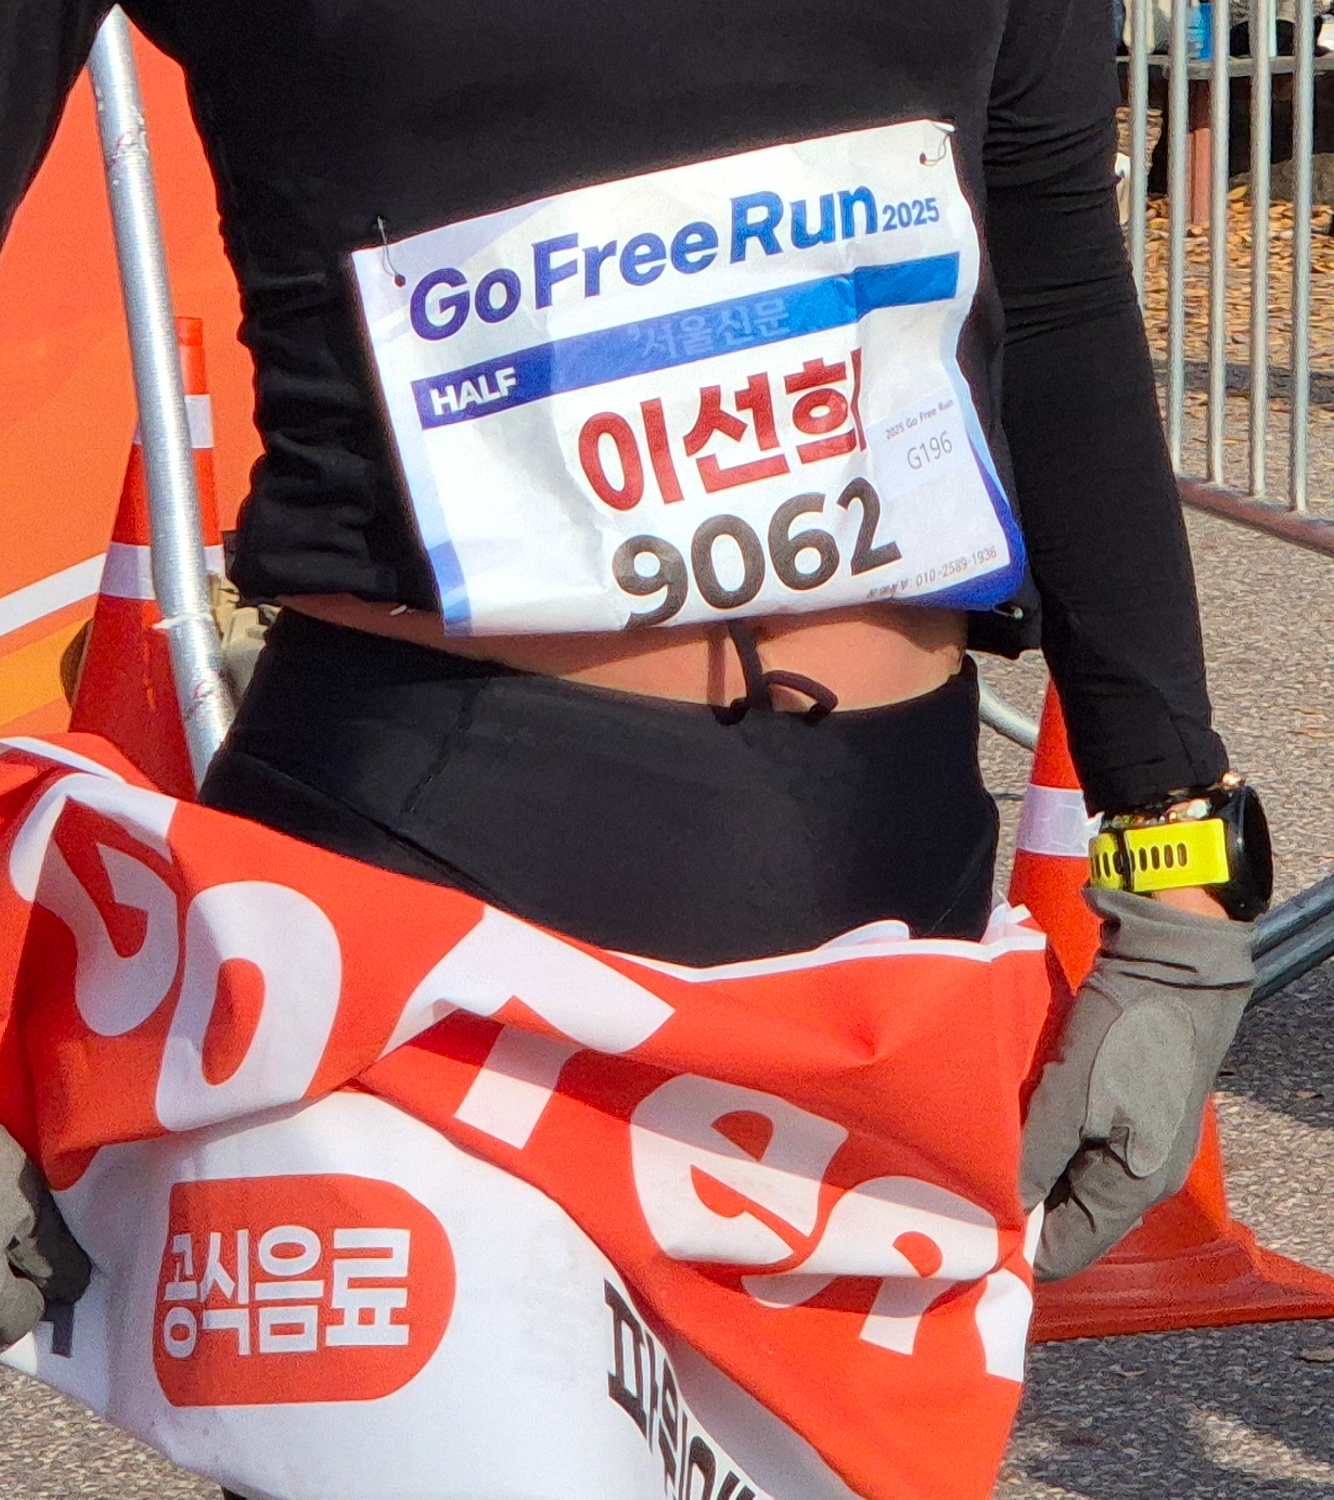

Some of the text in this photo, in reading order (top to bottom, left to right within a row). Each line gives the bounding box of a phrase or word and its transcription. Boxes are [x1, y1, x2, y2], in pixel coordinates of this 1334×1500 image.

[881, 196, 940, 233] 2025
[627, 296, 791, 360] 서울신문
[429, 366, 518, 417] HALF
[577, 346, 868, 512] 이선희
[907, 430, 954, 470] G196
[611, 476, 903, 629] 9062
[163, 1224, 411, 1359] 공식음료
